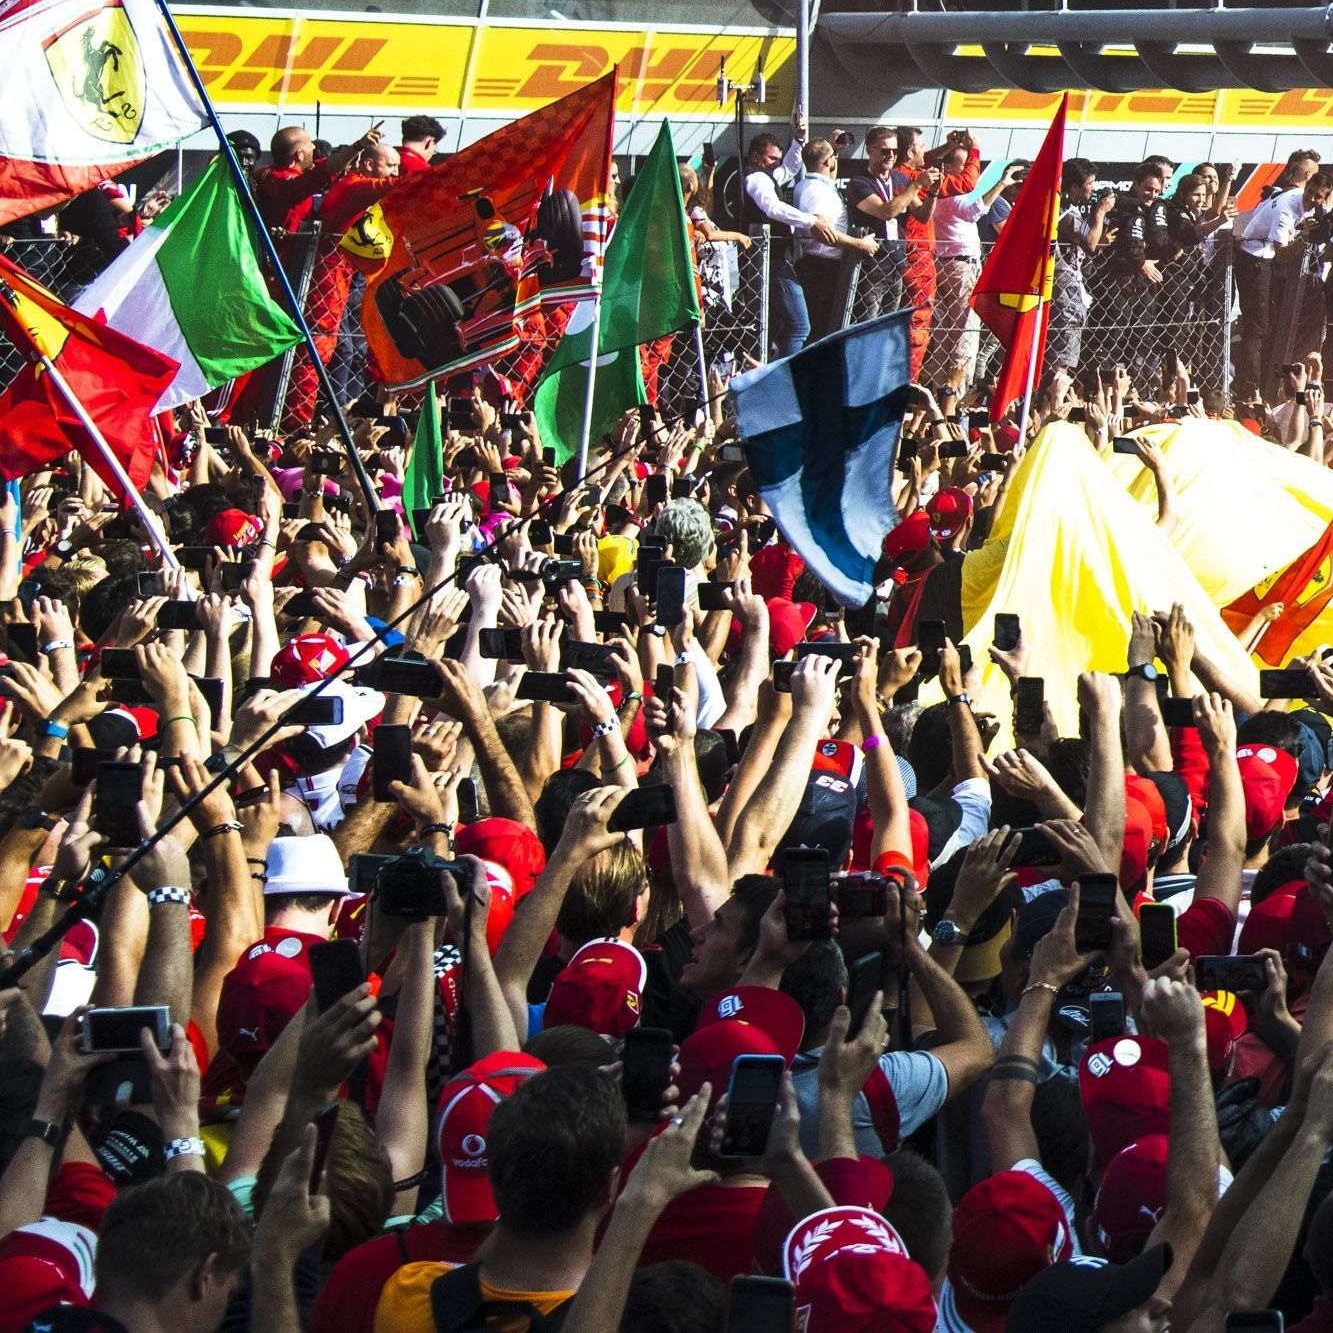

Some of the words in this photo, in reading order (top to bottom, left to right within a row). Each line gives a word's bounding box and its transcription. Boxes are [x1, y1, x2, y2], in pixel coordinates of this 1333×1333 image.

[176, 31, 388, 94] DHL
[517, 43, 735, 102] DHL
[452, 1157, 488, 1168] vodaf
